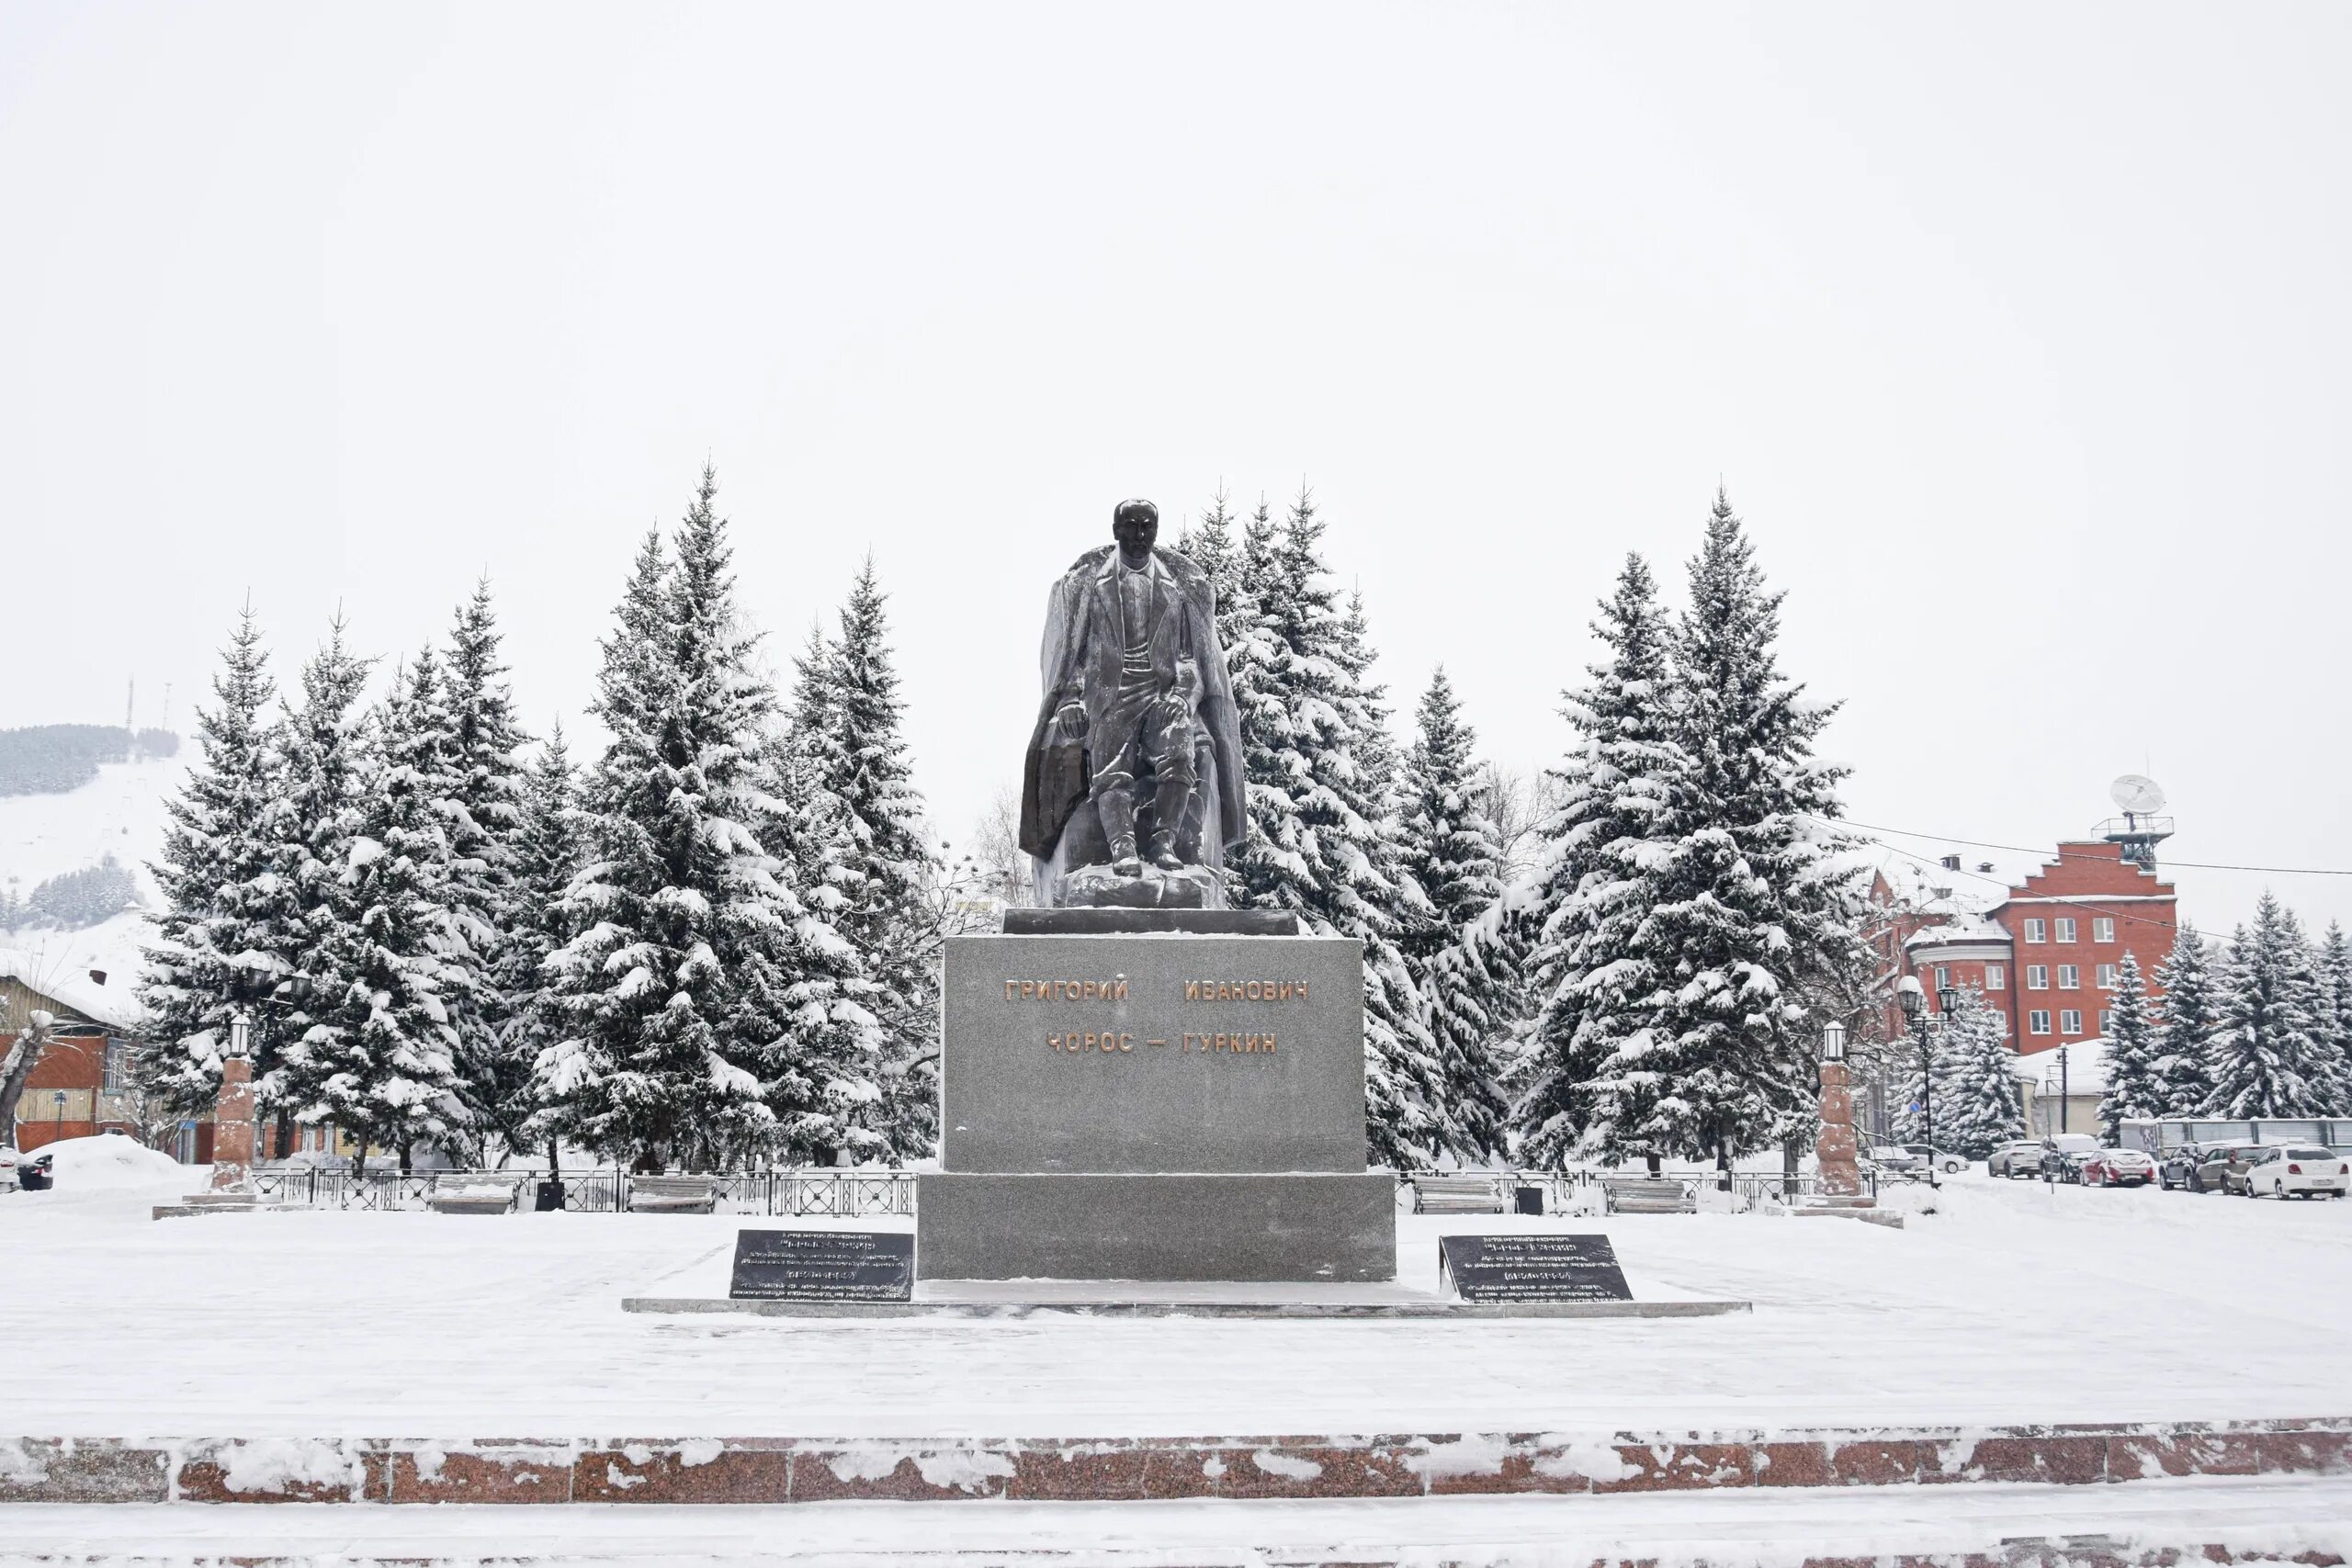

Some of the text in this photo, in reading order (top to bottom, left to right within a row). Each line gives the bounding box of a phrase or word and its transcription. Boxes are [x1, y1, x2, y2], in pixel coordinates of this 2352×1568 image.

[1005, 974, 1308, 1001] ГРИГОРИЙ ИВАНОВИЧ
[1047, 1032, 1134, 1054] ЧОРОС
[1182, 1032, 1277, 1054] ГУРКИН
